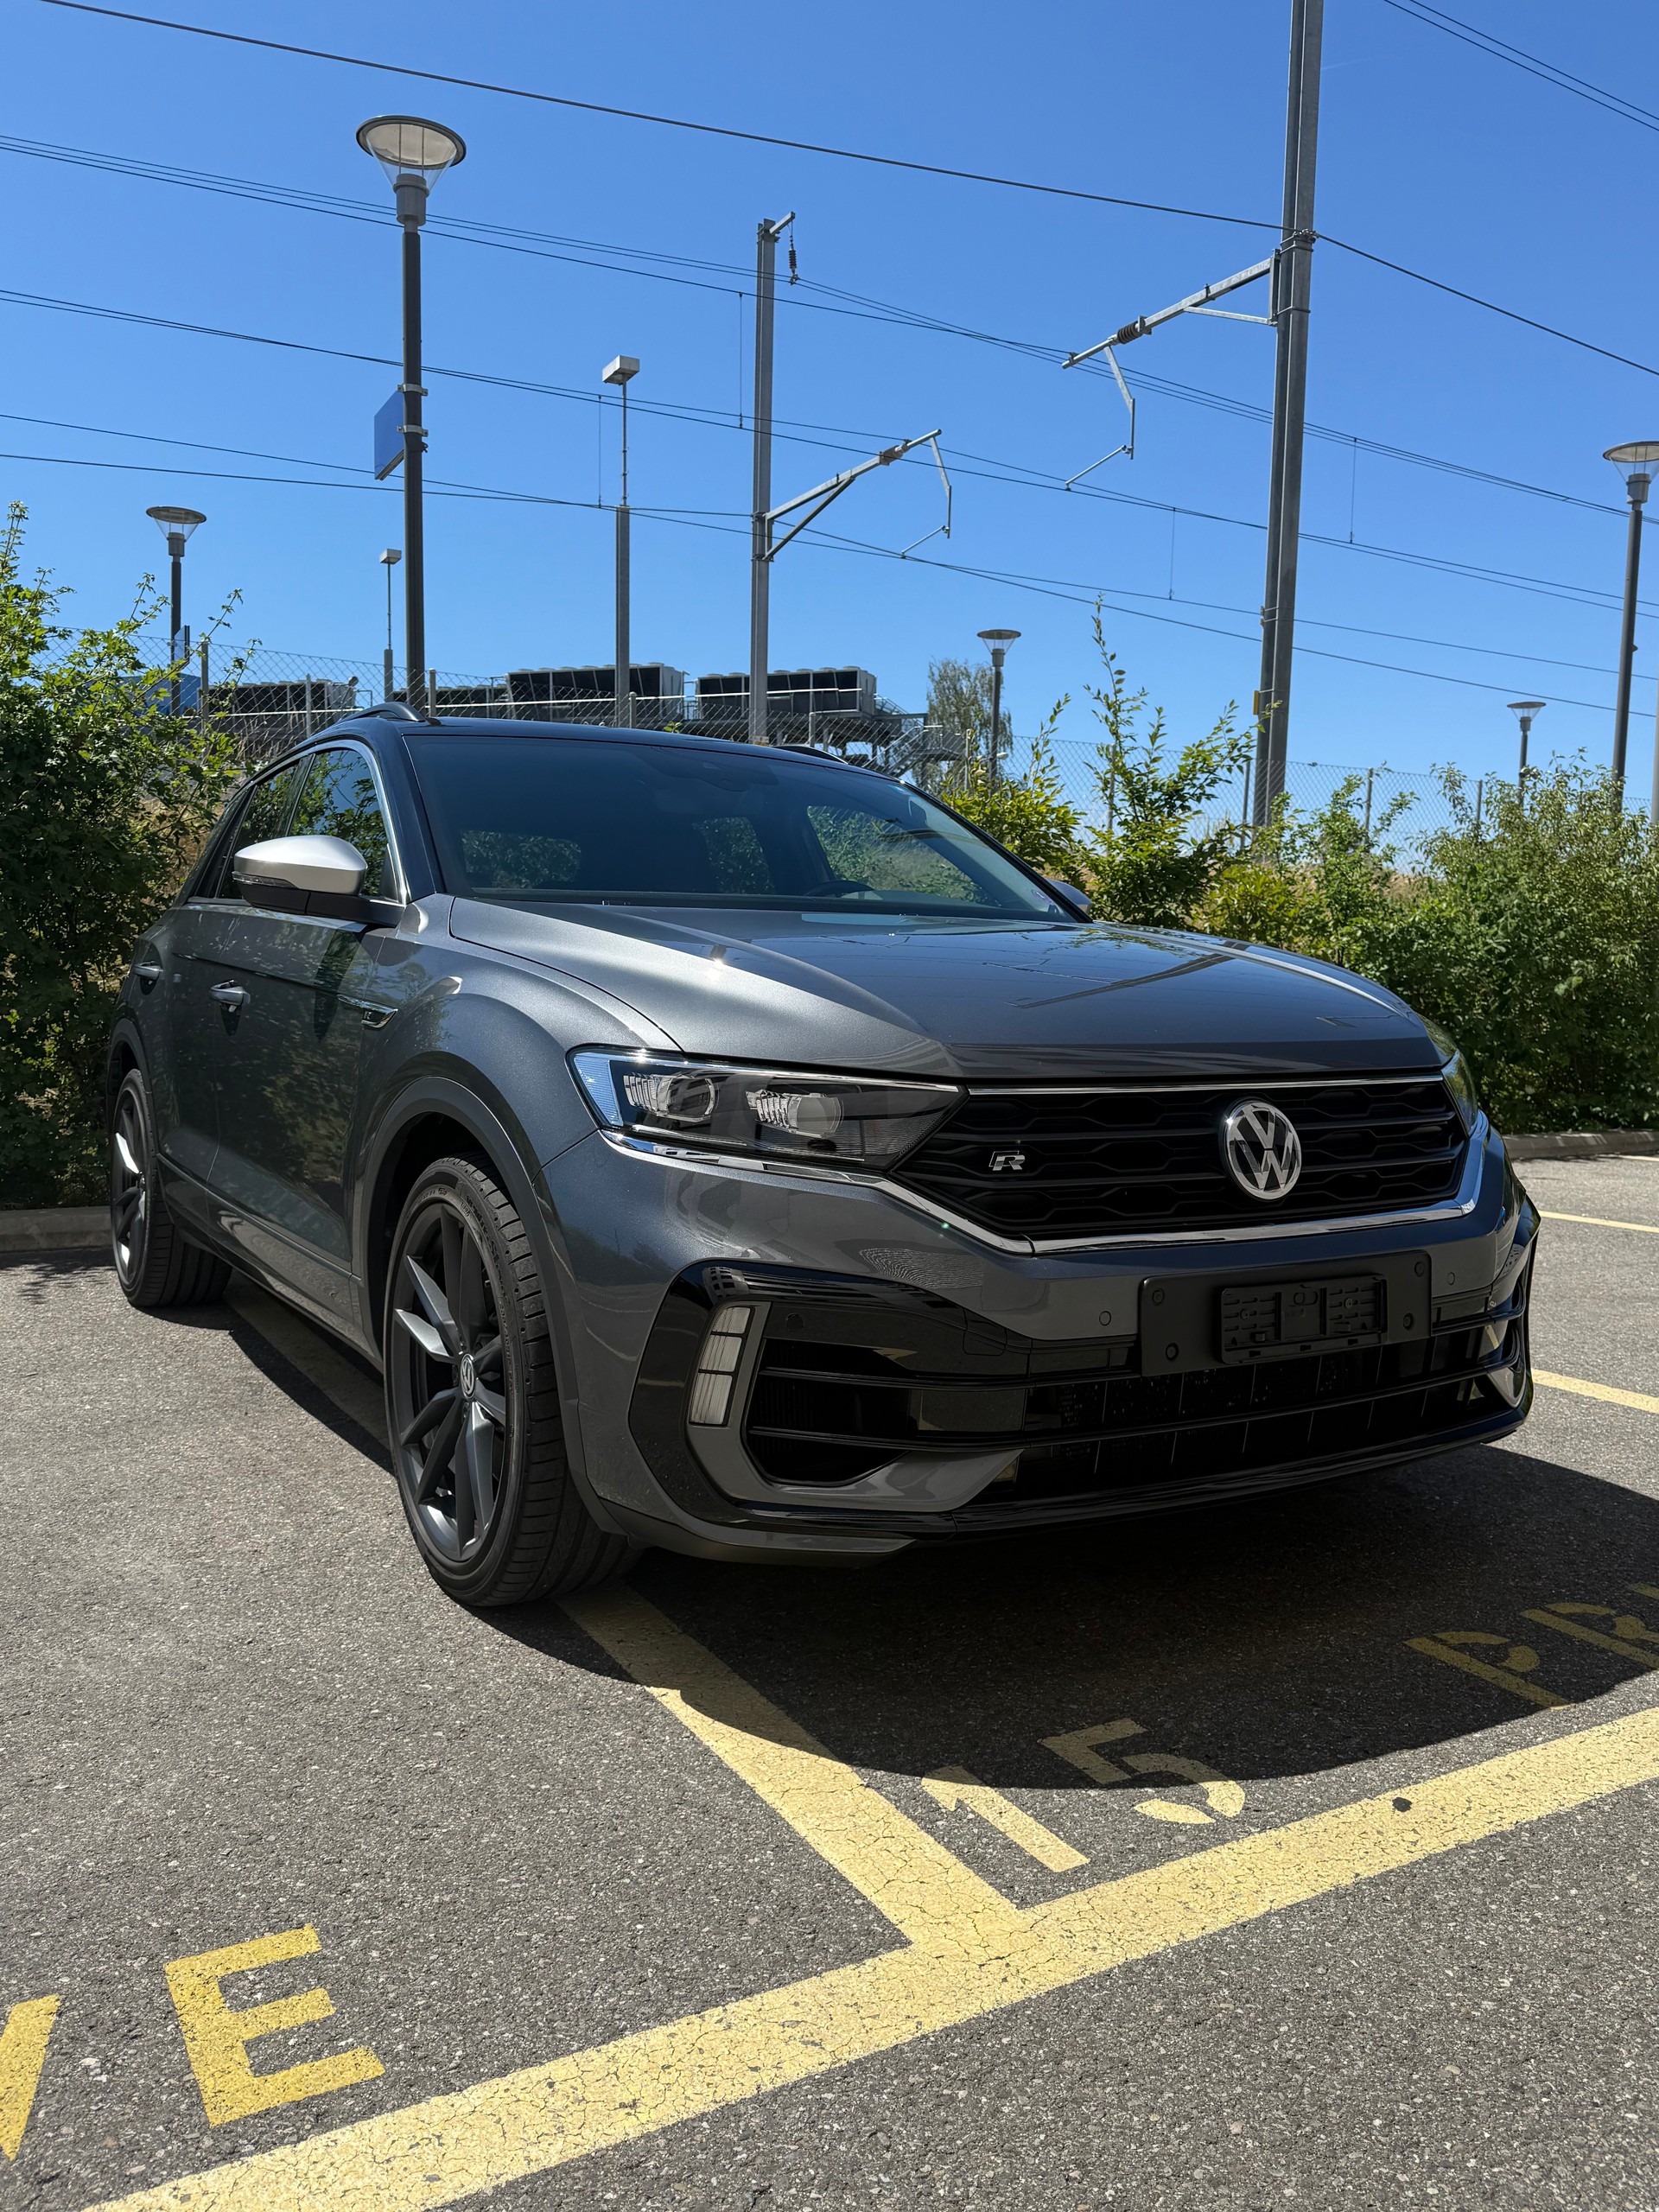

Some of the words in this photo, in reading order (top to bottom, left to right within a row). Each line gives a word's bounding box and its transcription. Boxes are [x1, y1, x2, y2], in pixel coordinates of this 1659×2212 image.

[990, 1152, 1025, 1171] R
[1227, 1102, 1301, 1199] VW
[921, 1718, 1245, 1872] 15
[1402, 1582, 1659, 1709] PR
